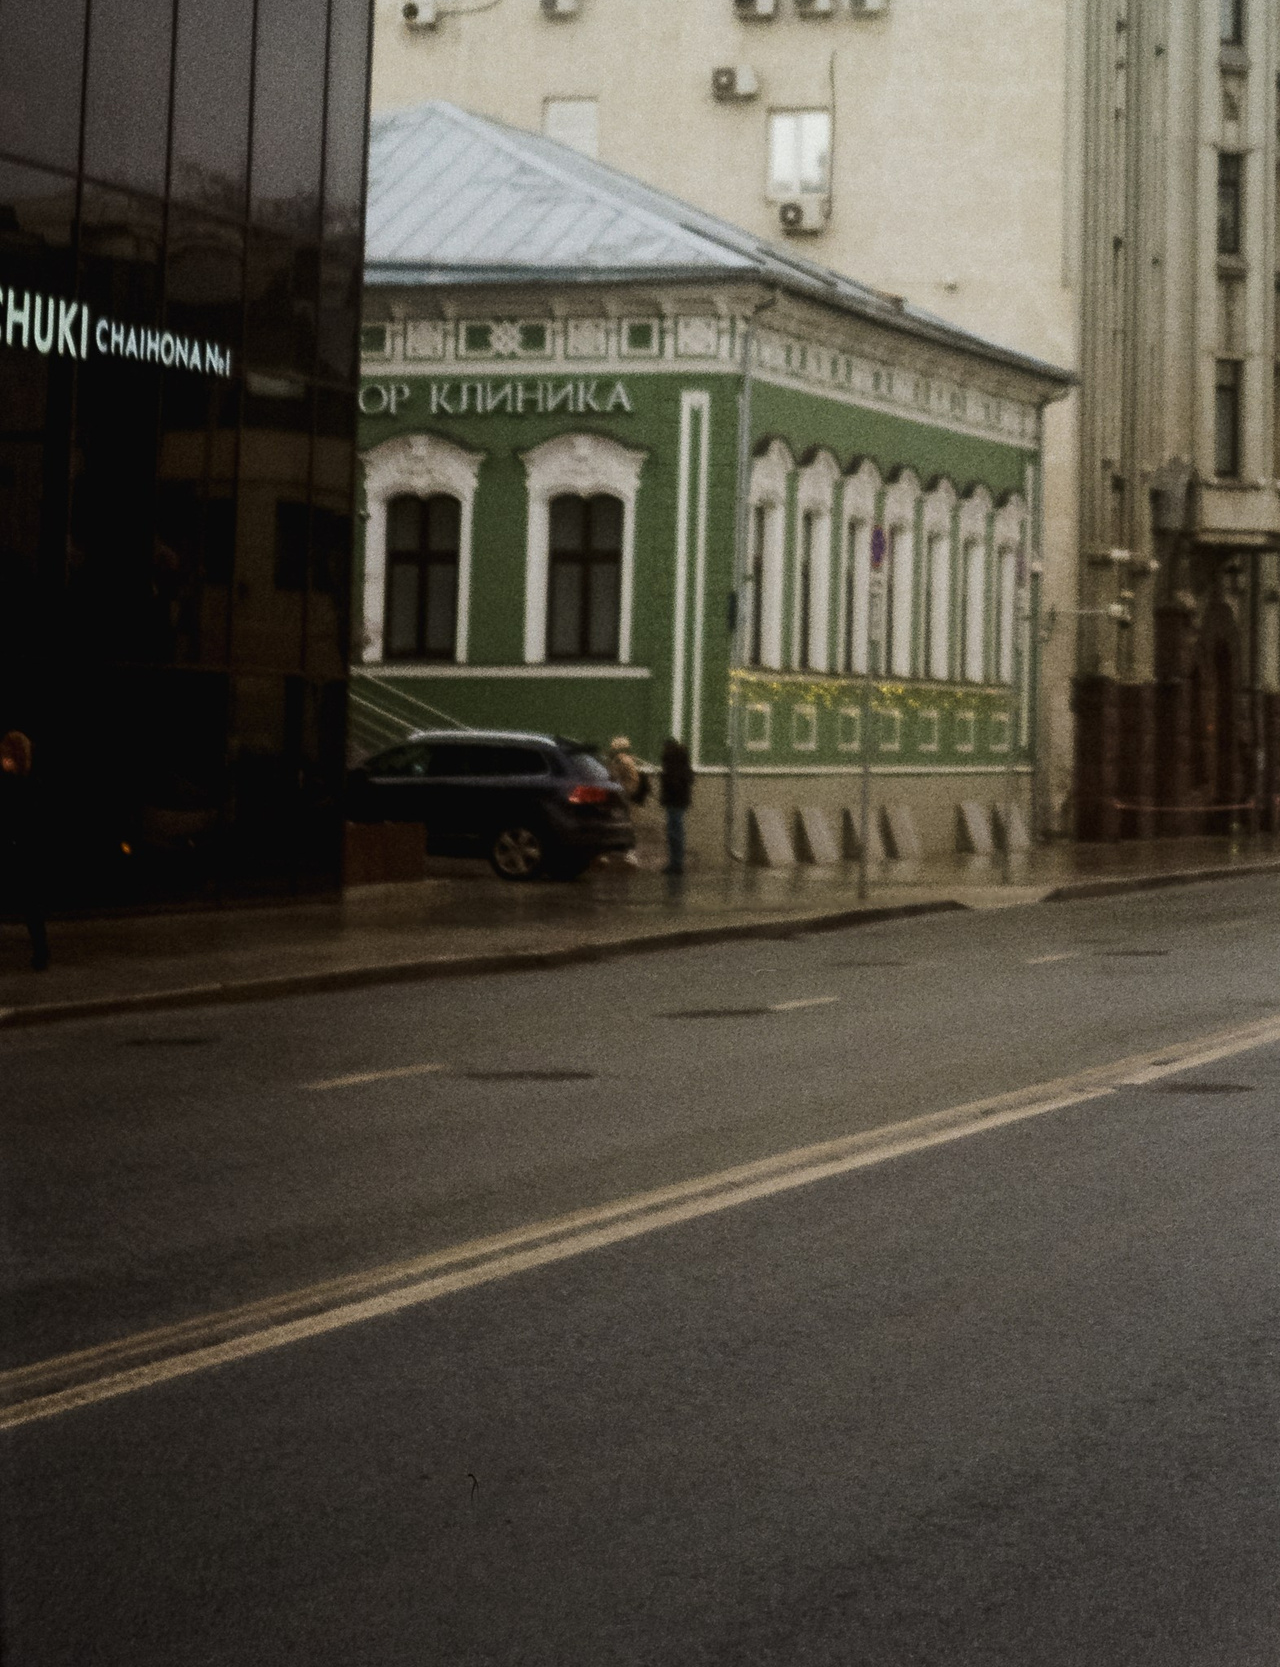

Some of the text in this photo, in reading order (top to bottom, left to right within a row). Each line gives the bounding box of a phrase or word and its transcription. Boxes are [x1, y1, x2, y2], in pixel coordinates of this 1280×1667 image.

[0, 285, 89, 361] HUKI
[95, 318, 202, 373] CHAIHONA
[429, 380, 633, 415] КЛИНИКА
